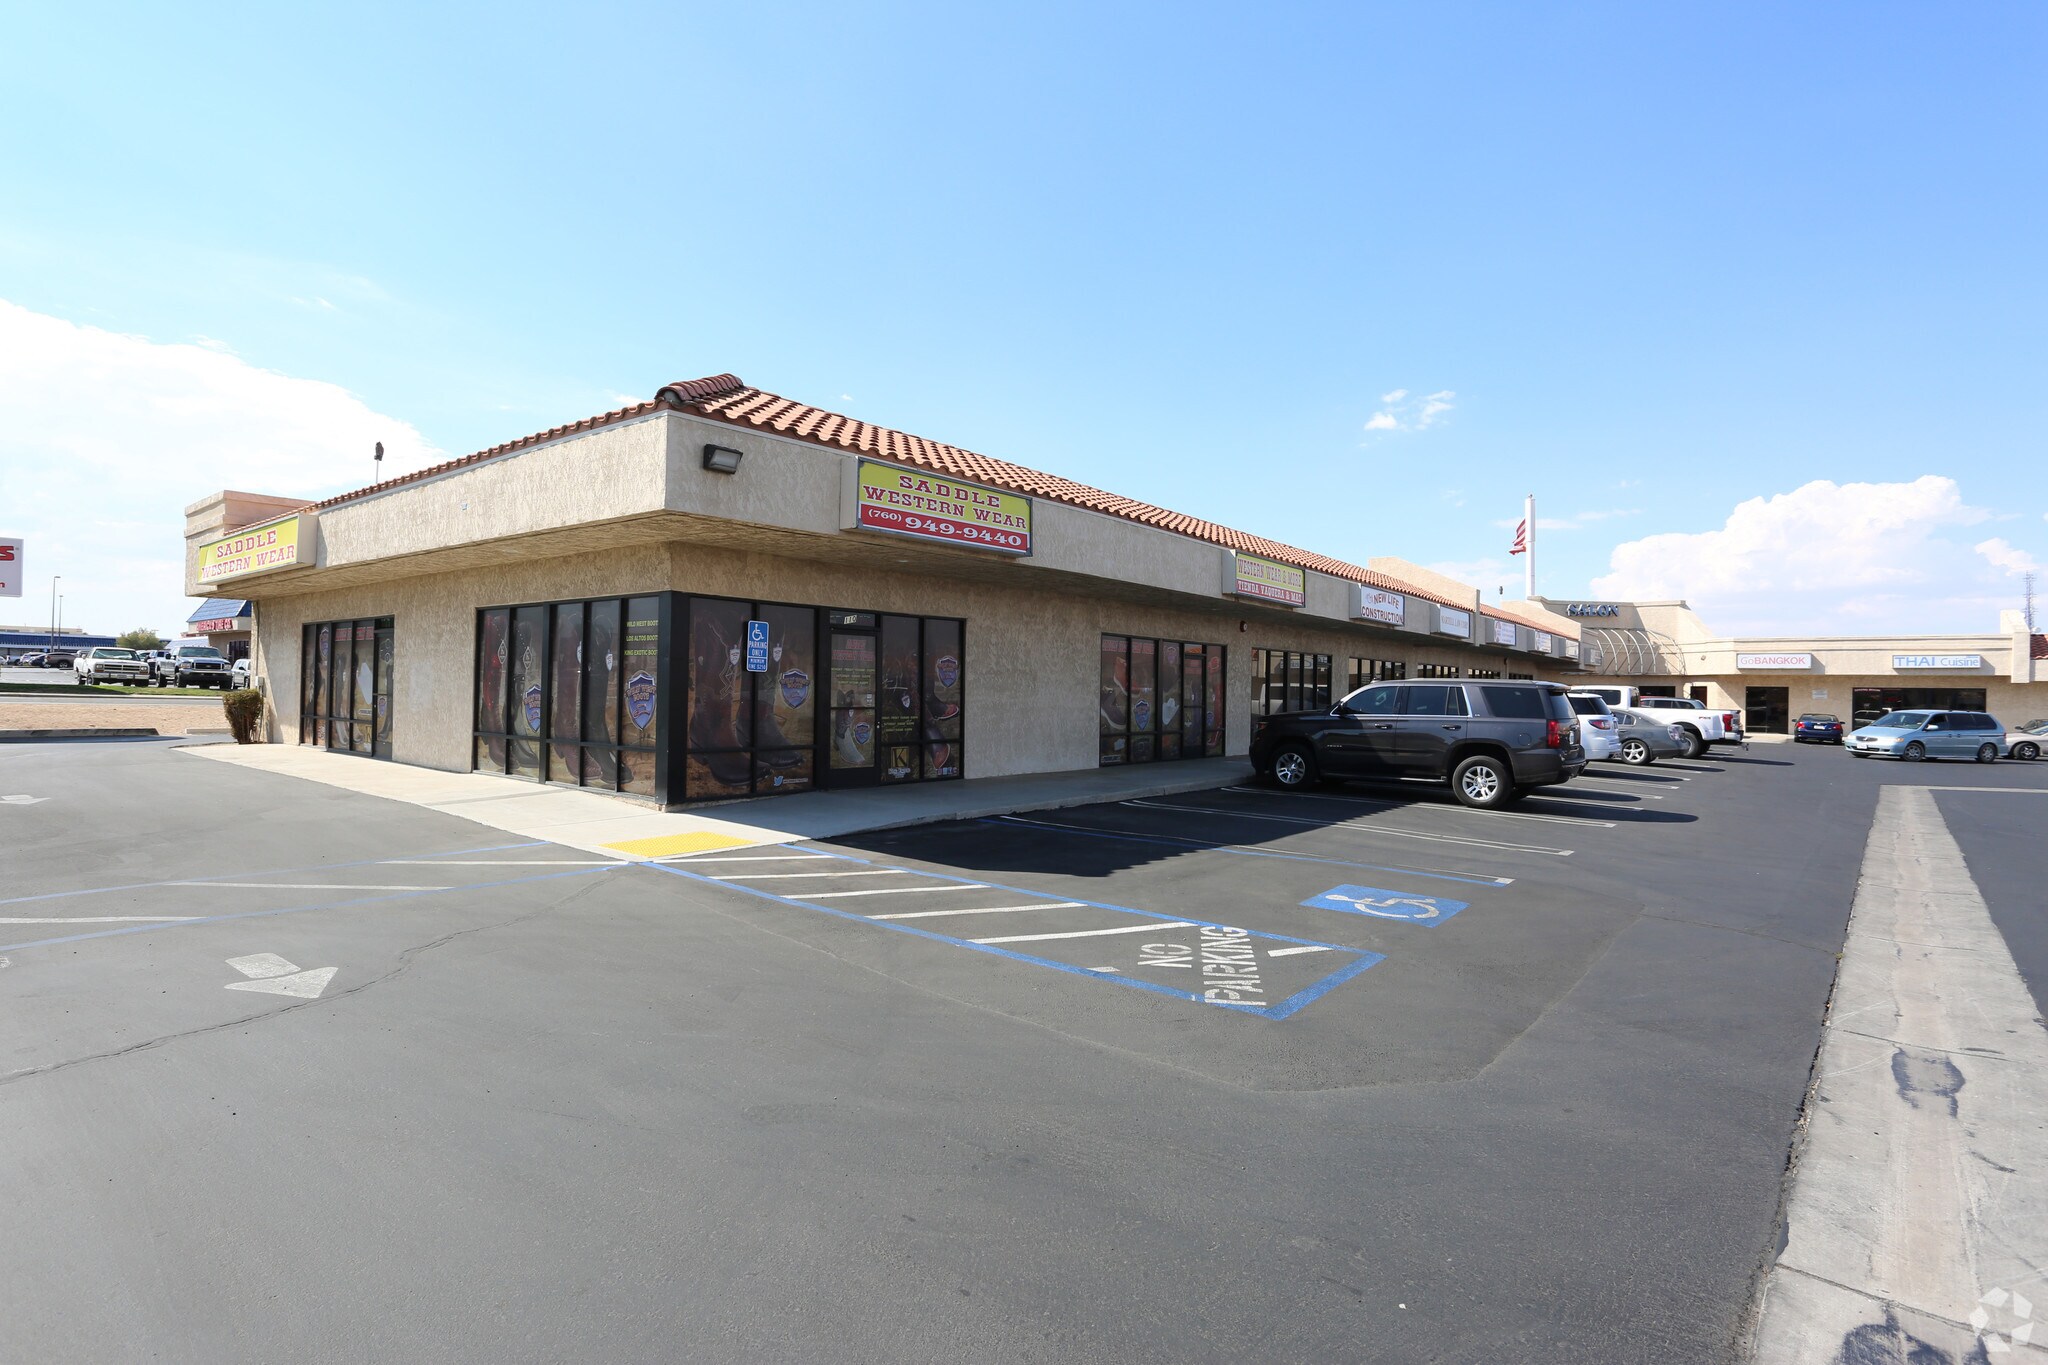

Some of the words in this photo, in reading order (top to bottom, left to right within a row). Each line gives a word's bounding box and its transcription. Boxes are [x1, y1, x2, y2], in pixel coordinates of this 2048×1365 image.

[899, 475, 1000, 508] SADDLE
[863, 485, 965, 517] WESTERN
[973, 507, 1027, 530] WEAR
[868, 508, 902, 523] (760)
[905, 516, 1022, 548] 949-9440
[217, 530, 276, 558] SADDLE
[202, 556, 251, 578] WESTERN
[256, 545, 295, 567] WEAR
[1237, 558, 1264, 579] WESTERN
[1265, 565, 1281, 583] WEAR
[1287, 571, 1301, 588] MORE
[1237, 580, 1260, 594] TIENDA
[1260, 585, 1285, 599] VAQUERA
[1290, 592, 1302, 602] MAS
[1373, 593, 1387, 605] NEW
[1387, 593, 1400, 610] LIFE
[1361, 606, 1404, 624] CONSTRUCTION
[1567, 604, 1620, 617] SALON
[749, 641, 767, 649] PARKING
[751, 649, 764, 657] ONLY
[1895, 656, 1935, 667] THAI
[1940, 657, 1979, 667] Cuisine
[1138, 944, 1194, 969] NO
[1200, 926, 1266, 1006] PARKING
